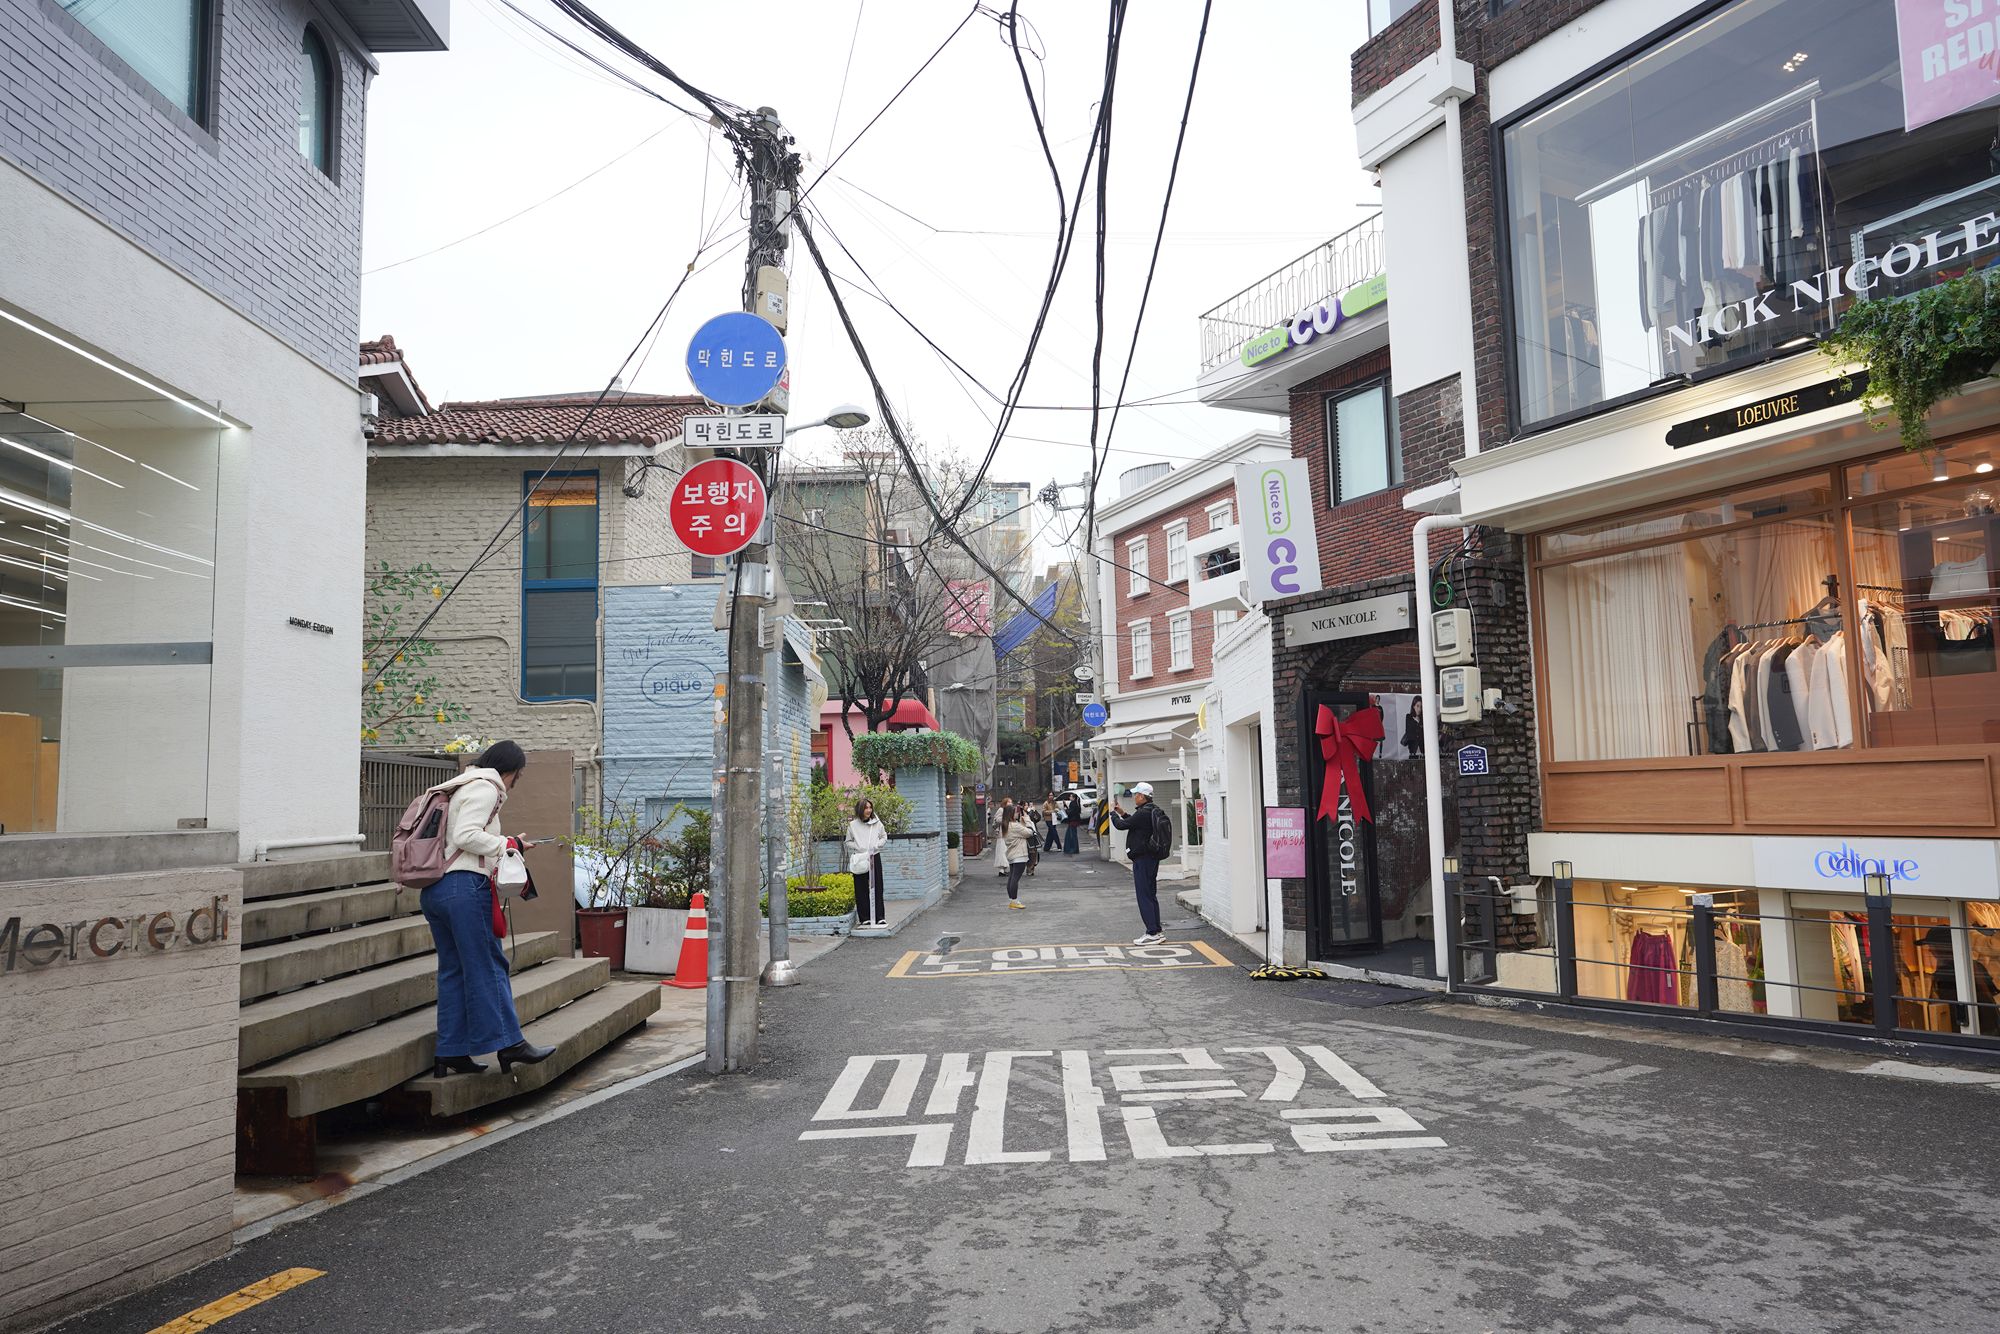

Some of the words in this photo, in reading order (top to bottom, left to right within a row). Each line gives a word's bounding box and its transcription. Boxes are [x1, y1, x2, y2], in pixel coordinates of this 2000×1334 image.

[1921, 15, 2000, 82] RED
[1666, 289, 1780, 355] NICK
[1790, 211, 2000, 313] NICOLE
[1246, 342, 1269, 360] Nice
[1270, 336, 1281, 348] to
[1291, 296, 1339, 345] CU
[698, 348, 778, 368] 막힌도로
[1736, 394, 1799, 428] LOEUVRE
[695, 422, 774, 442] 막힌도로
[681, 480, 756, 506] 보행자
[1268, 480, 1280, 509] Nice
[1272, 511, 1282, 525] to
[1267, 537, 1300, 594] CU
[1311, 617, 1337, 632] NICK
[1338, 610, 1377, 627] NICOLE
[653, 678, 702, 695] pique
[1462, 759, 1484, 771] 58-3
[1266, 817, 1293, 828] SPRING
[1338, 794, 1357, 896] NICOLE
[798, 1045, 1448, 1167] 막다른길
